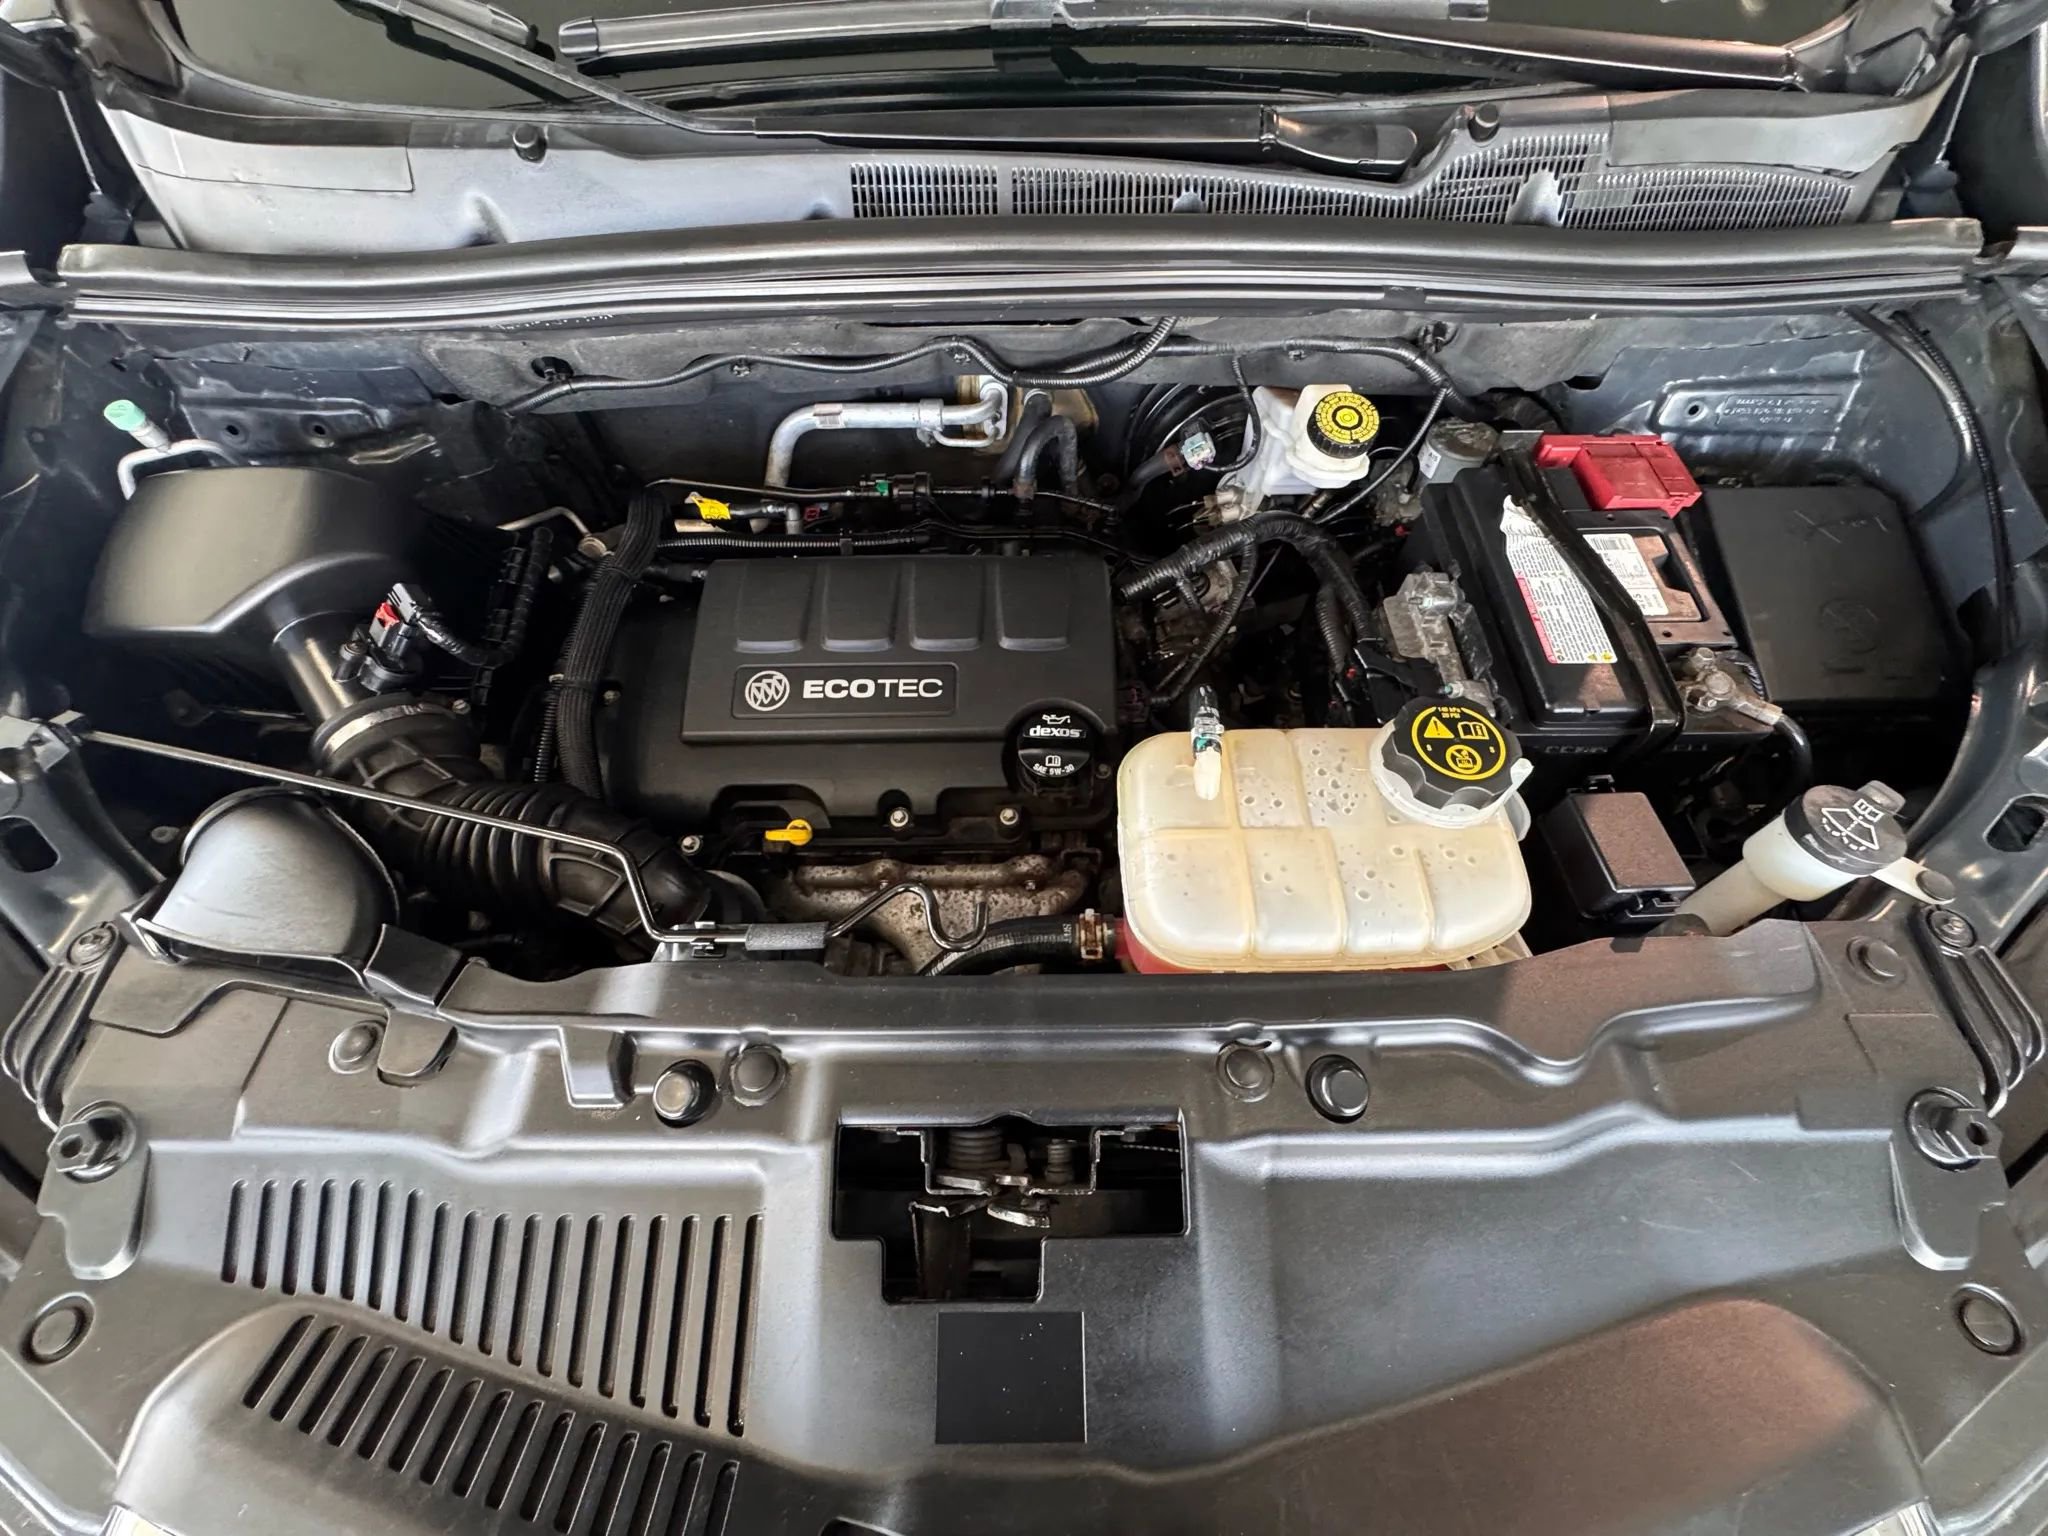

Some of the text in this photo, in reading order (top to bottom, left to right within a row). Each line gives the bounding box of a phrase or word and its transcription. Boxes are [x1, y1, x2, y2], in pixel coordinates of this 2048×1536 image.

[802, 678, 943, 699] ECOTEC
[1029, 725, 1081, 738] dexos
[1033, 763, 1048, 775] SAE
